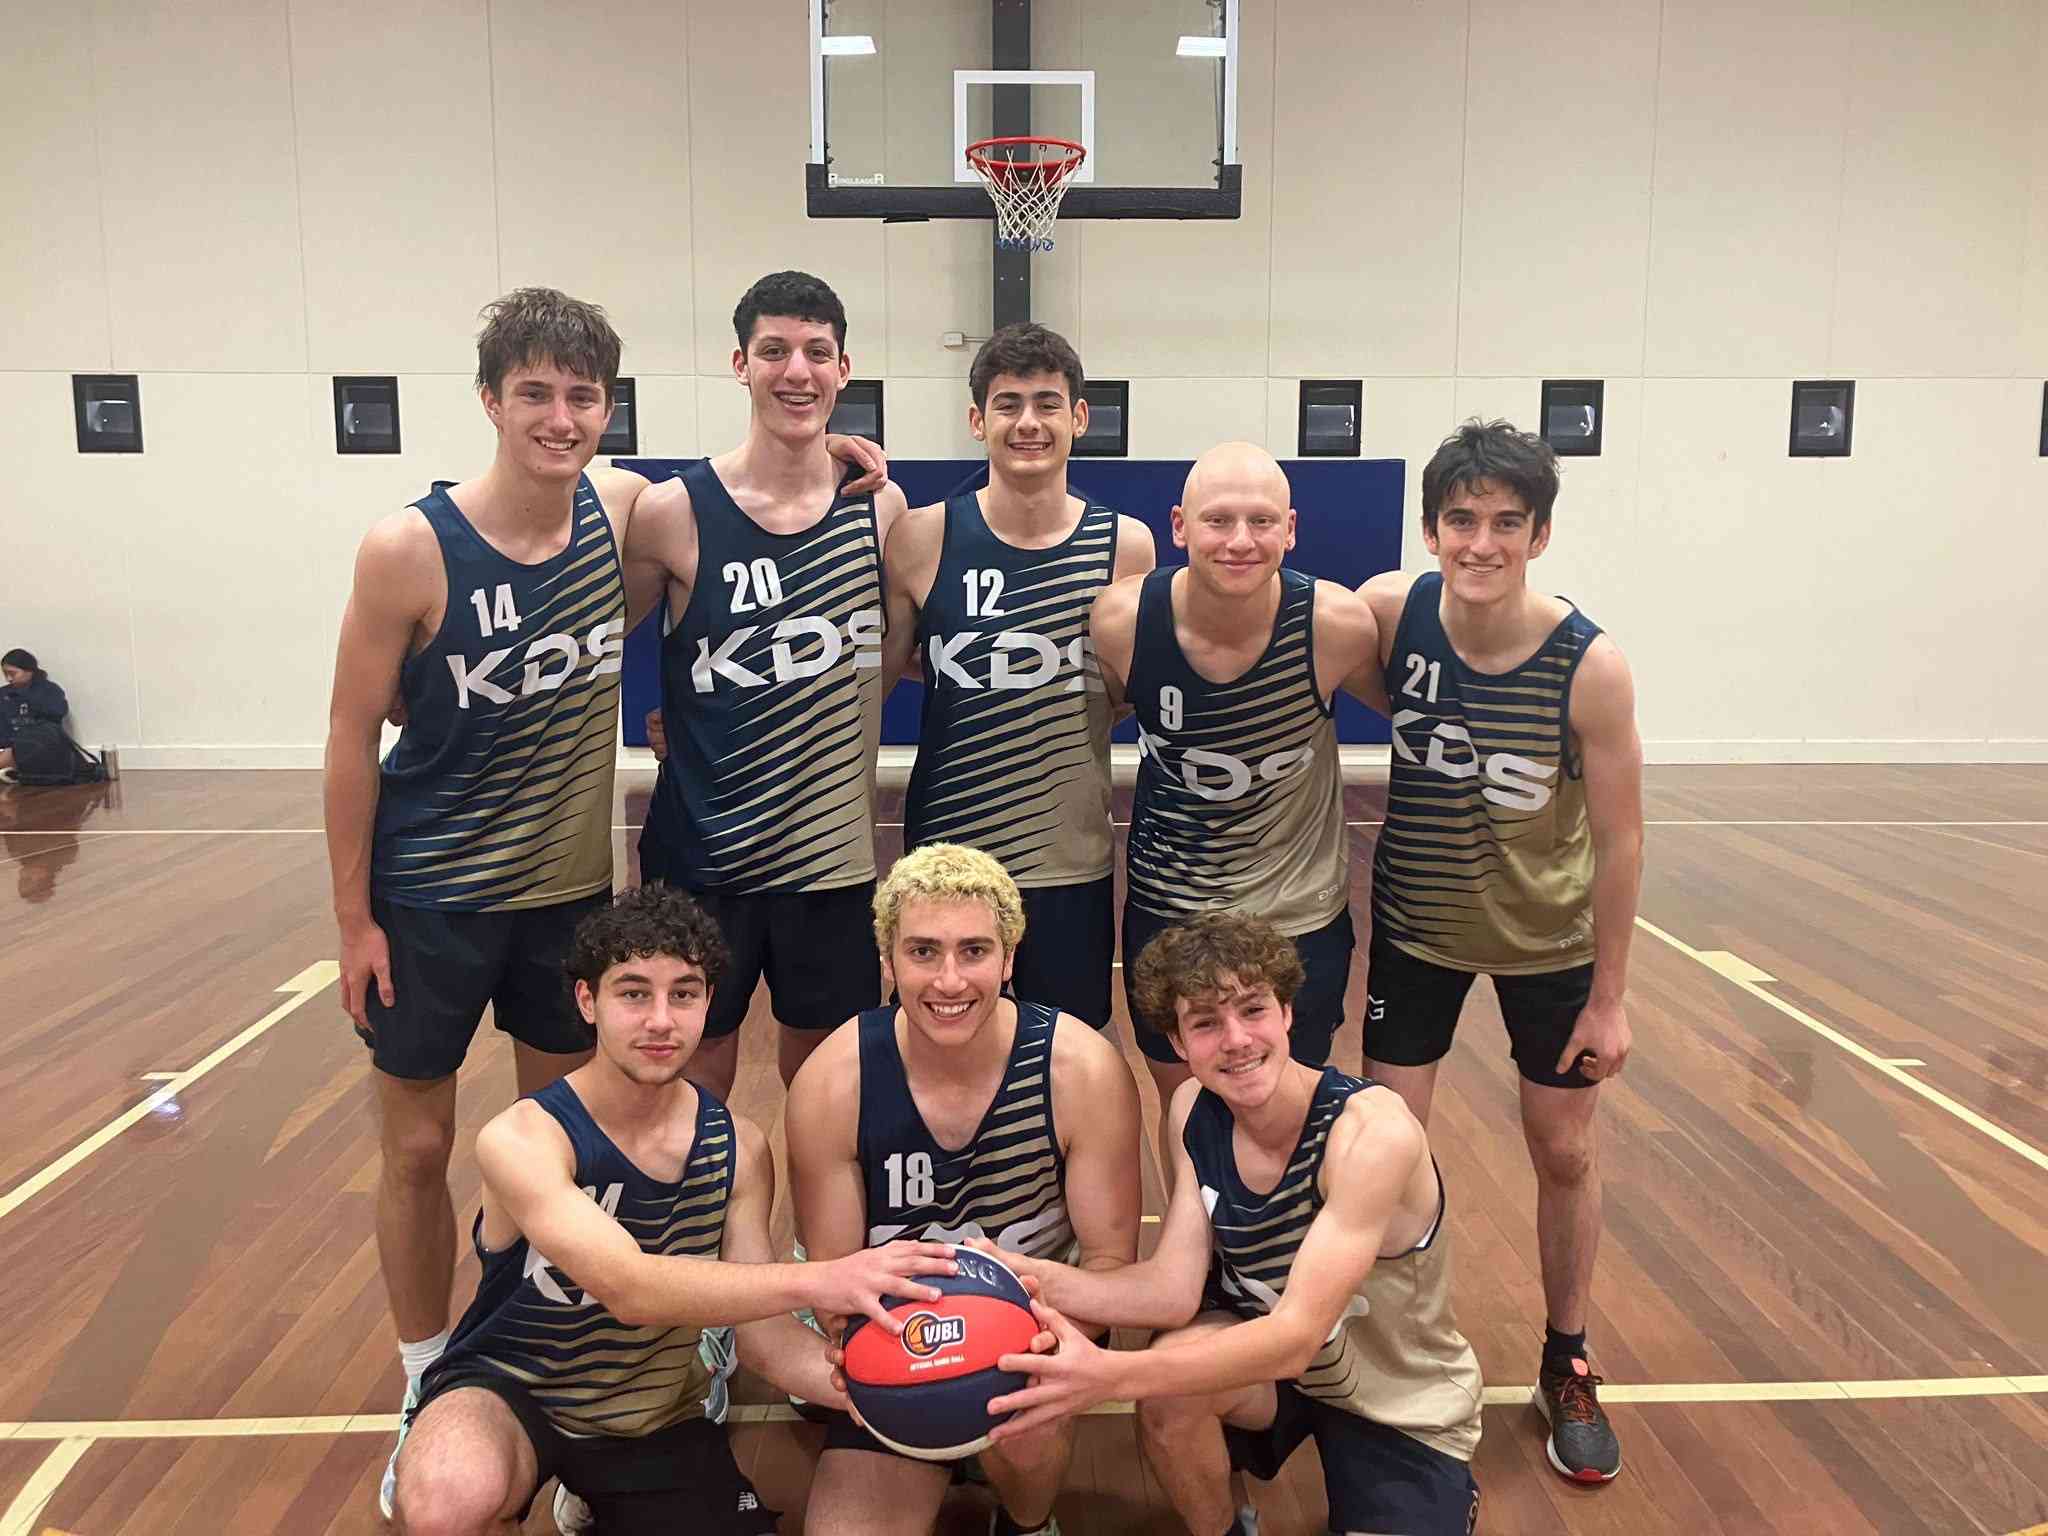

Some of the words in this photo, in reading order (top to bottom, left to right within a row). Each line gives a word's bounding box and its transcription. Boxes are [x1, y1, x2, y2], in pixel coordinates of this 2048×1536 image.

[470, 583, 522, 637] 14
[722, 557, 784, 614] 20
[963, 569, 1005, 616] 12
[446, 617, 623, 709] KDS
[1402, 653, 1441, 703] 21
[1159, 685, 1183, 731] 9
[1392, 708, 1558, 811] KDS
[884, 1152, 935, 1208] 18
[923, 1320, 961, 1344] VJBL
